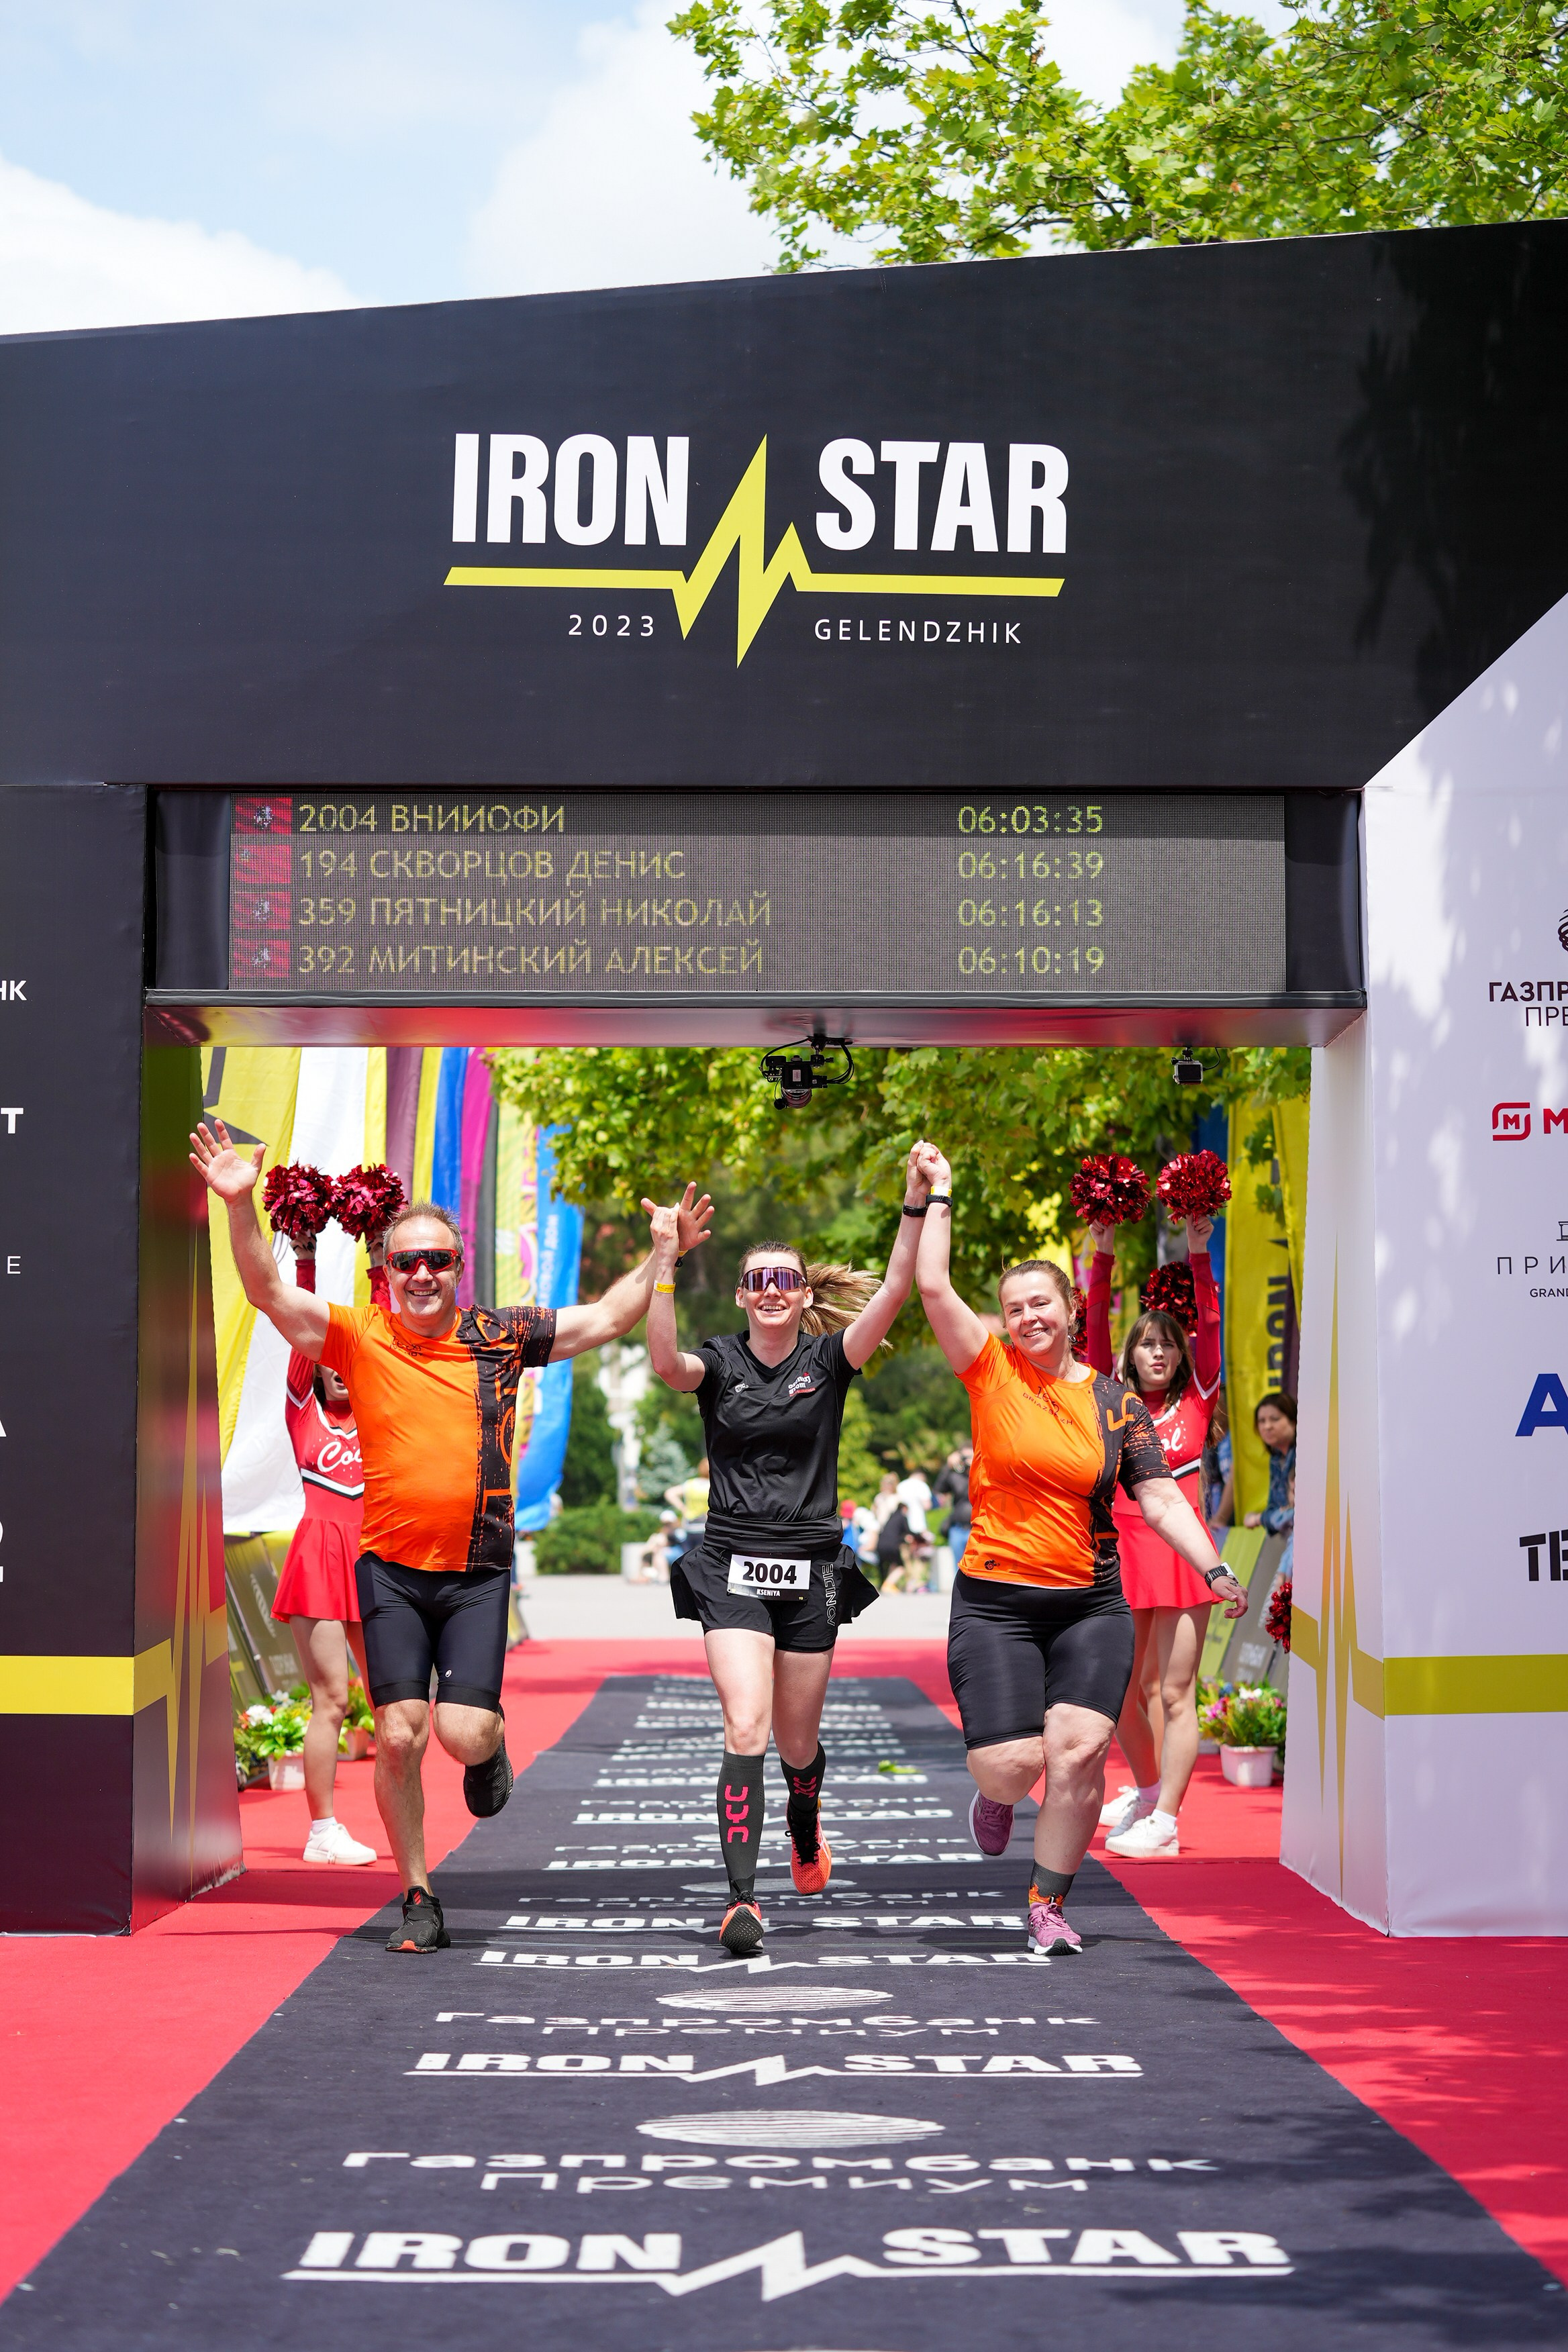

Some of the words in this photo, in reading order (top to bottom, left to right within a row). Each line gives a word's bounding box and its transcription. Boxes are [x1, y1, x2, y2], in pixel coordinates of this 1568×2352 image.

[452, 433, 690, 546] IRON
[816, 438, 1070, 554] STAR
[569, 614, 656, 638] 2023
[815, 619, 1022, 644] GELENDZHIK
[299, 805, 377, 832] 2004
[391, 805, 565, 832] ВНИИОФИ
[959, 806, 1103, 834] 06:03:35
[301, 851, 355, 878] 194
[370, 850, 554, 886] СКВОРЦОВ
[566, 851, 685, 886] ДЕНИС
[959, 852, 1104, 879] 06:16:39
[299, 898, 356, 926] 359
[371, 890, 587, 934] ПЯТНИЦКИЙ
[603, 890, 771, 926] НИКОЛАЙ
[959, 899, 1103, 926] 06:16:13
[299, 945, 355, 973] 392
[370, 938, 591, 974] МИТИНСКИЙ
[607, 938, 763, 974] АЛЕКСЕЙ
[959, 946, 1104, 974] 06:10:19
[742, 1561, 797, 1584] 2004
[756, 1588, 780, 1596] KSENIYA
[548, 1859, 715, 1868] IRON
[505, 1916, 705, 1928] IRON
[812, 1915, 1024, 1927] STAR
[480, 1951, 699, 1966] IRON
[818, 1953, 1051, 1965] STAR
[436, 2012, 1101, 2026] Газпромбанк
[542, 2026, 999, 2037] Премиум
[415, 2053, 694, 2072] IRON
[844, 2055, 1143, 2073] STAR
[342, 2151, 1220, 2172] Газпромбанк
[481, 2172, 1089, 2194] Премиум
[299, 2232, 682, 2271] IRON
[881, 2227, 1291, 2266] STAR
